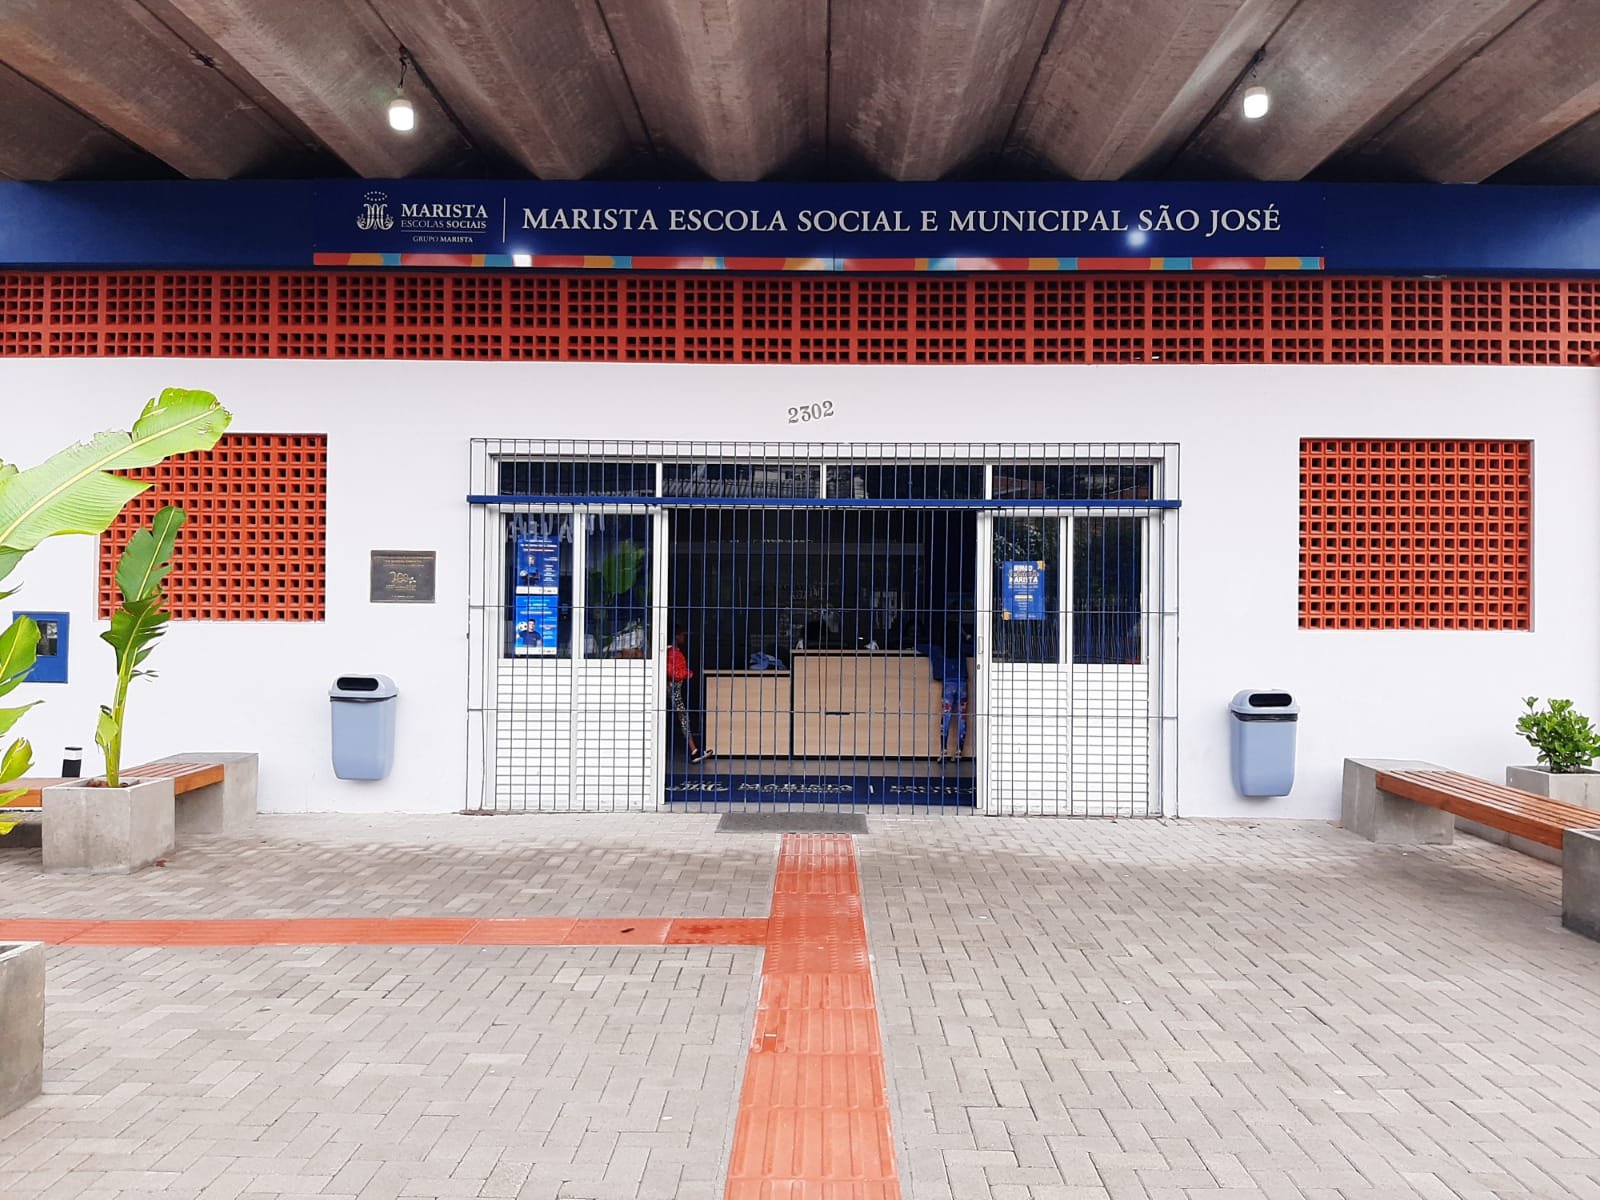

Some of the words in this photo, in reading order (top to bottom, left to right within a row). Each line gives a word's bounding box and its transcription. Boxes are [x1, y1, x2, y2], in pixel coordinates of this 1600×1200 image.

[400, 203, 489, 219] MARISTA
[400, 219, 445, 229] ESCOLAS
[446, 219, 487, 230] SOCIAIS
[522, 207, 660, 232] MARISTA
[669, 208, 789, 233] ESCOLA
[797, 208, 911, 233] SOCIAL
[920, 209, 939, 232] E
[949, 208, 1129, 233] MUNICIPAL
[1137, 203, 1200, 233] SÃO
[1204, 202, 1281, 238] JOSÉ
[412, 235, 439, 243] GRUPO
[439, 236, 473, 244] MARISTA
[787, 399, 835, 424] 2302
